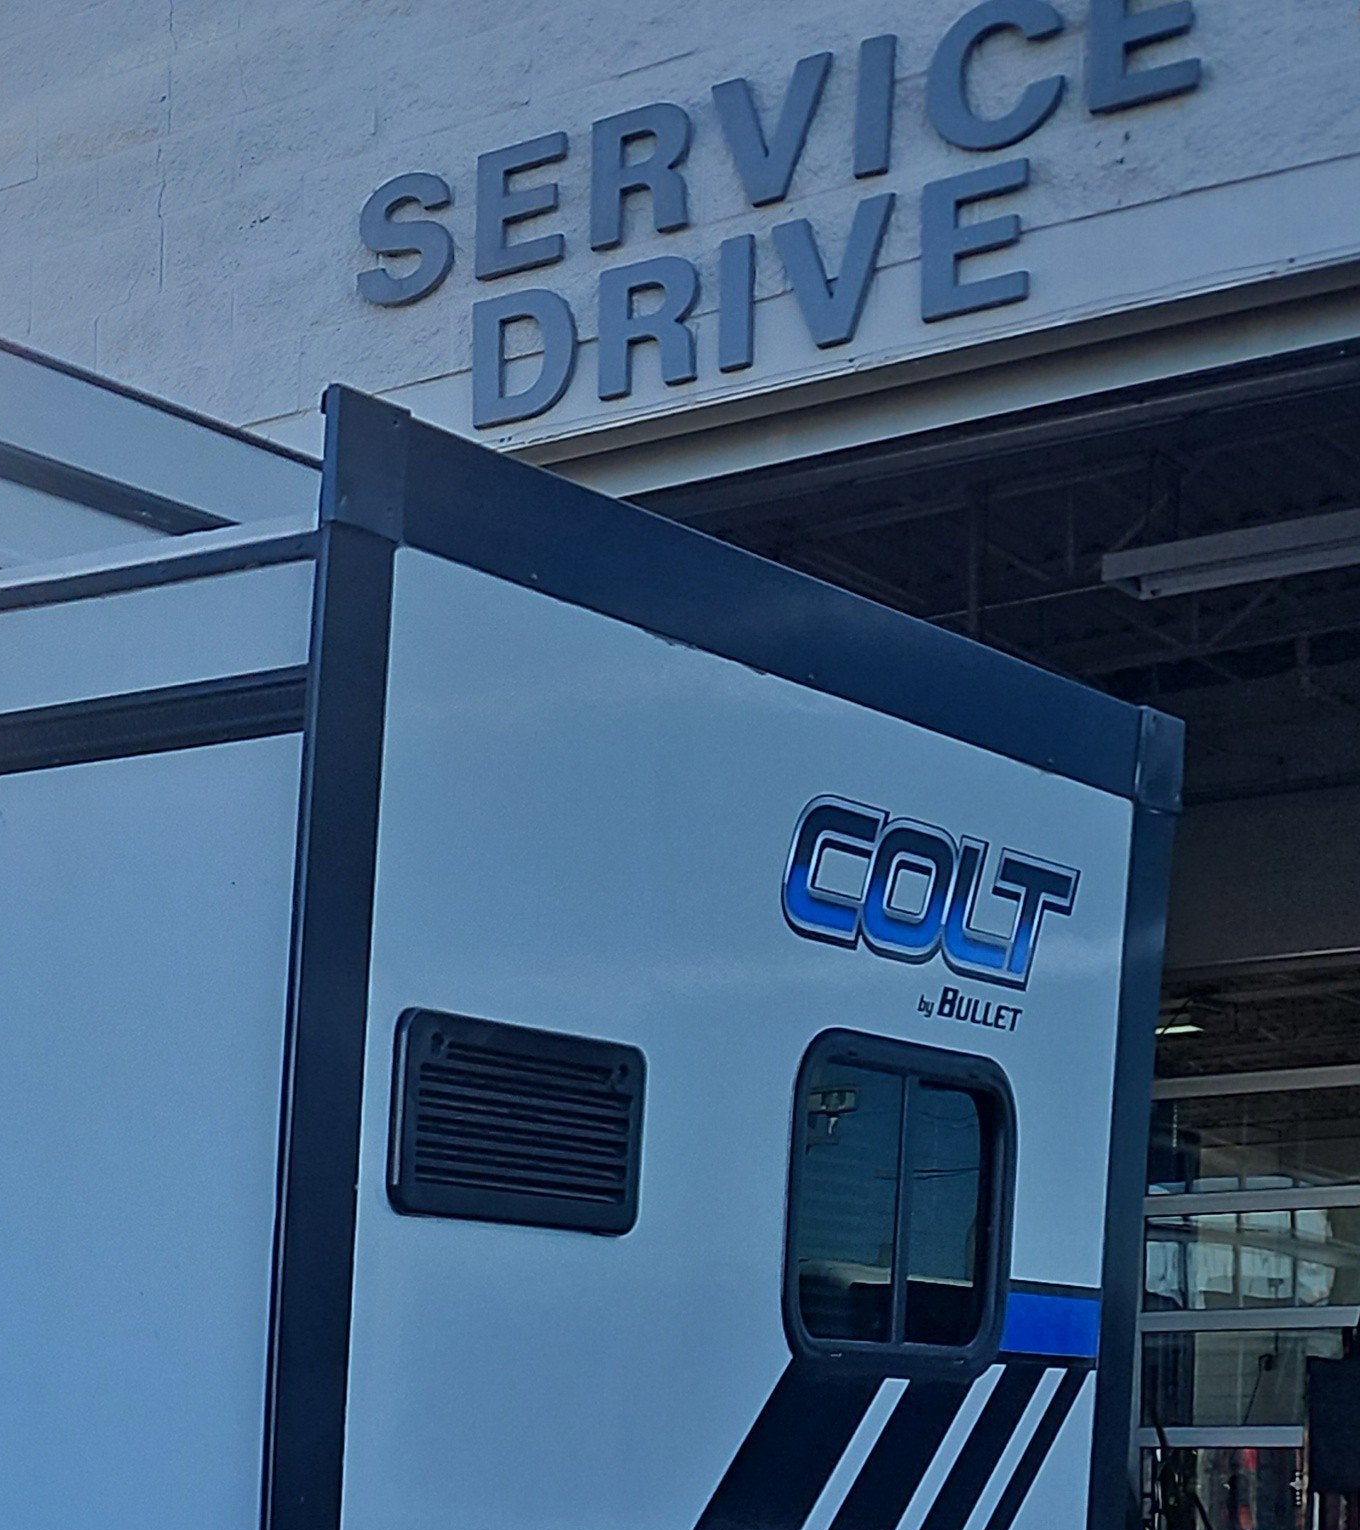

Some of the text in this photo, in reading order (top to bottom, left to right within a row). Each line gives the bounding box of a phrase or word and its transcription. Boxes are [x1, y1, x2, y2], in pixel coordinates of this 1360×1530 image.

[356, 0, 1202, 309] SERVICE
[472, 156, 1032, 430] DRIVE
[780, 793, 1082, 993] COLT
[917, 985, 1024, 1032] by BULLET
